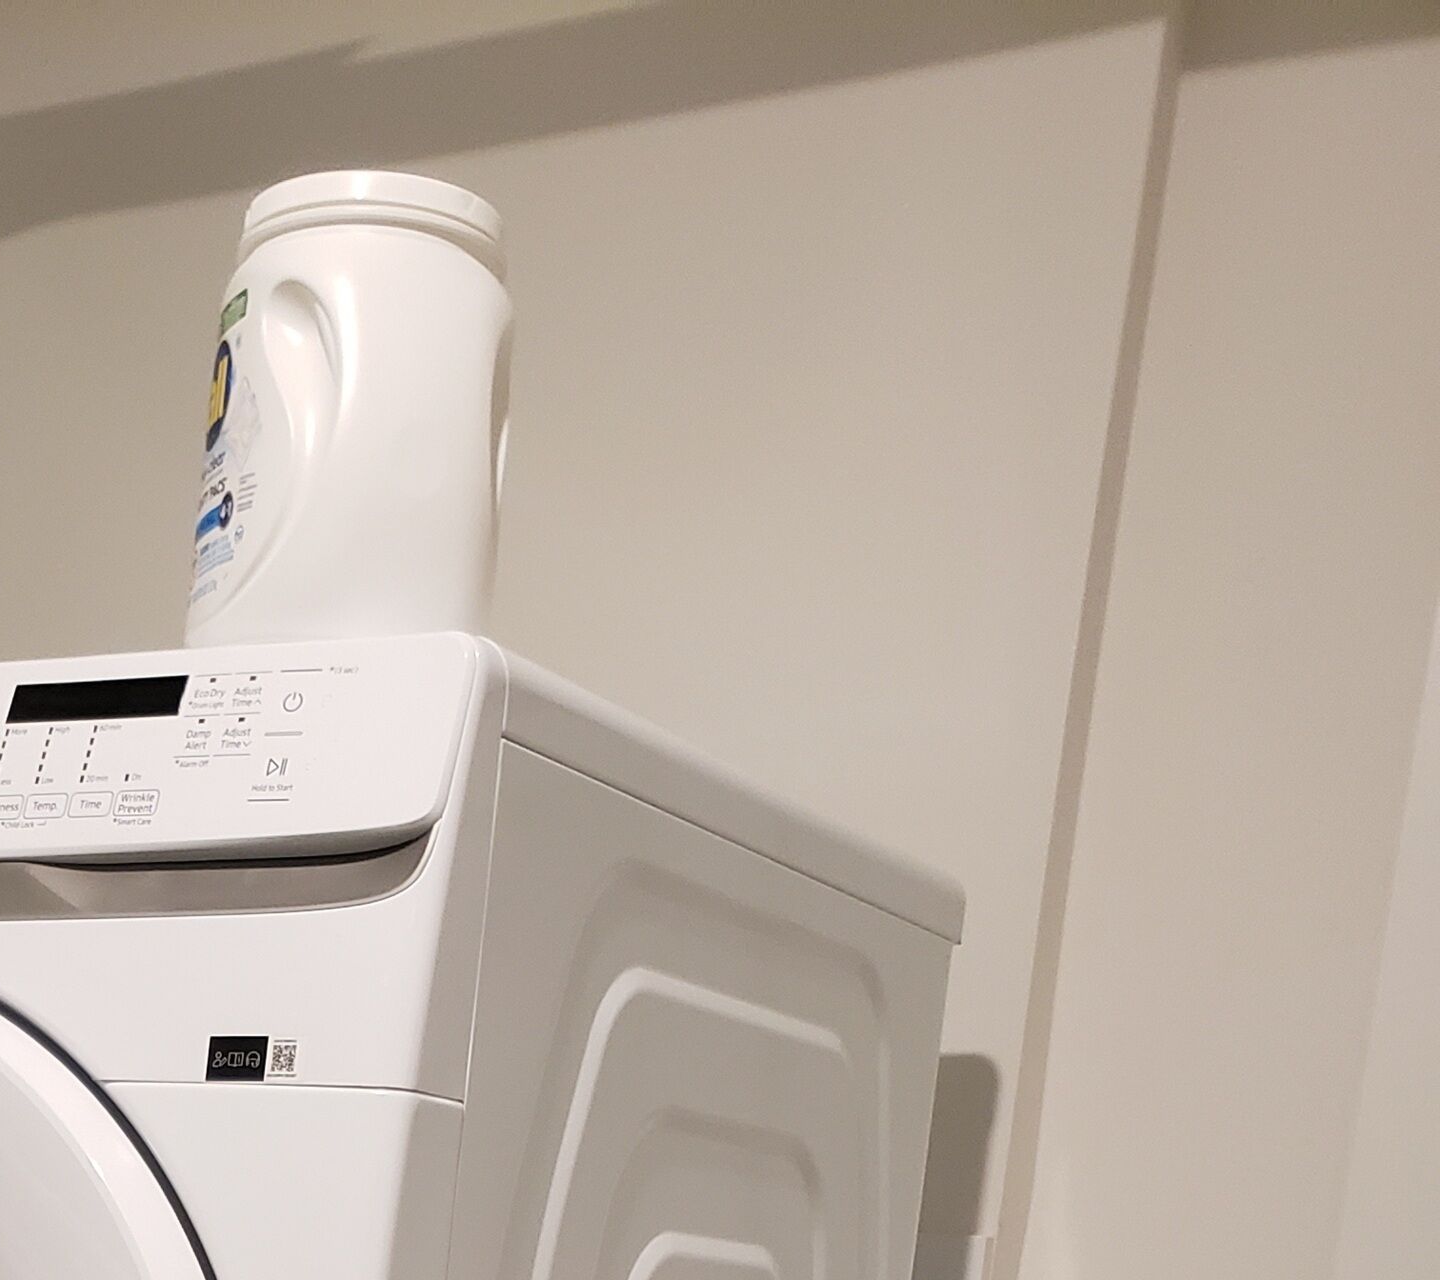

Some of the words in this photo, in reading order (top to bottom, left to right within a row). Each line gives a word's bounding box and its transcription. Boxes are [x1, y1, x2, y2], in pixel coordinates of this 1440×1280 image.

[210, 689, 226, 700] Dry
[235, 687, 262, 698] Adjust
[232, 699, 252, 707] Time
[186, 729, 212, 740] Damp
[223, 728, 251, 740] Adjust
[185, 741, 207, 750] Alert
[220, 740, 241, 749] Time
[251, 784, 268, 792] Hold
[276, 784, 294, 792] Start
[121, 793, 155, 802] Wrinkle
[80, 800, 102, 809] Time
[118, 804, 153, 813] Prevent
